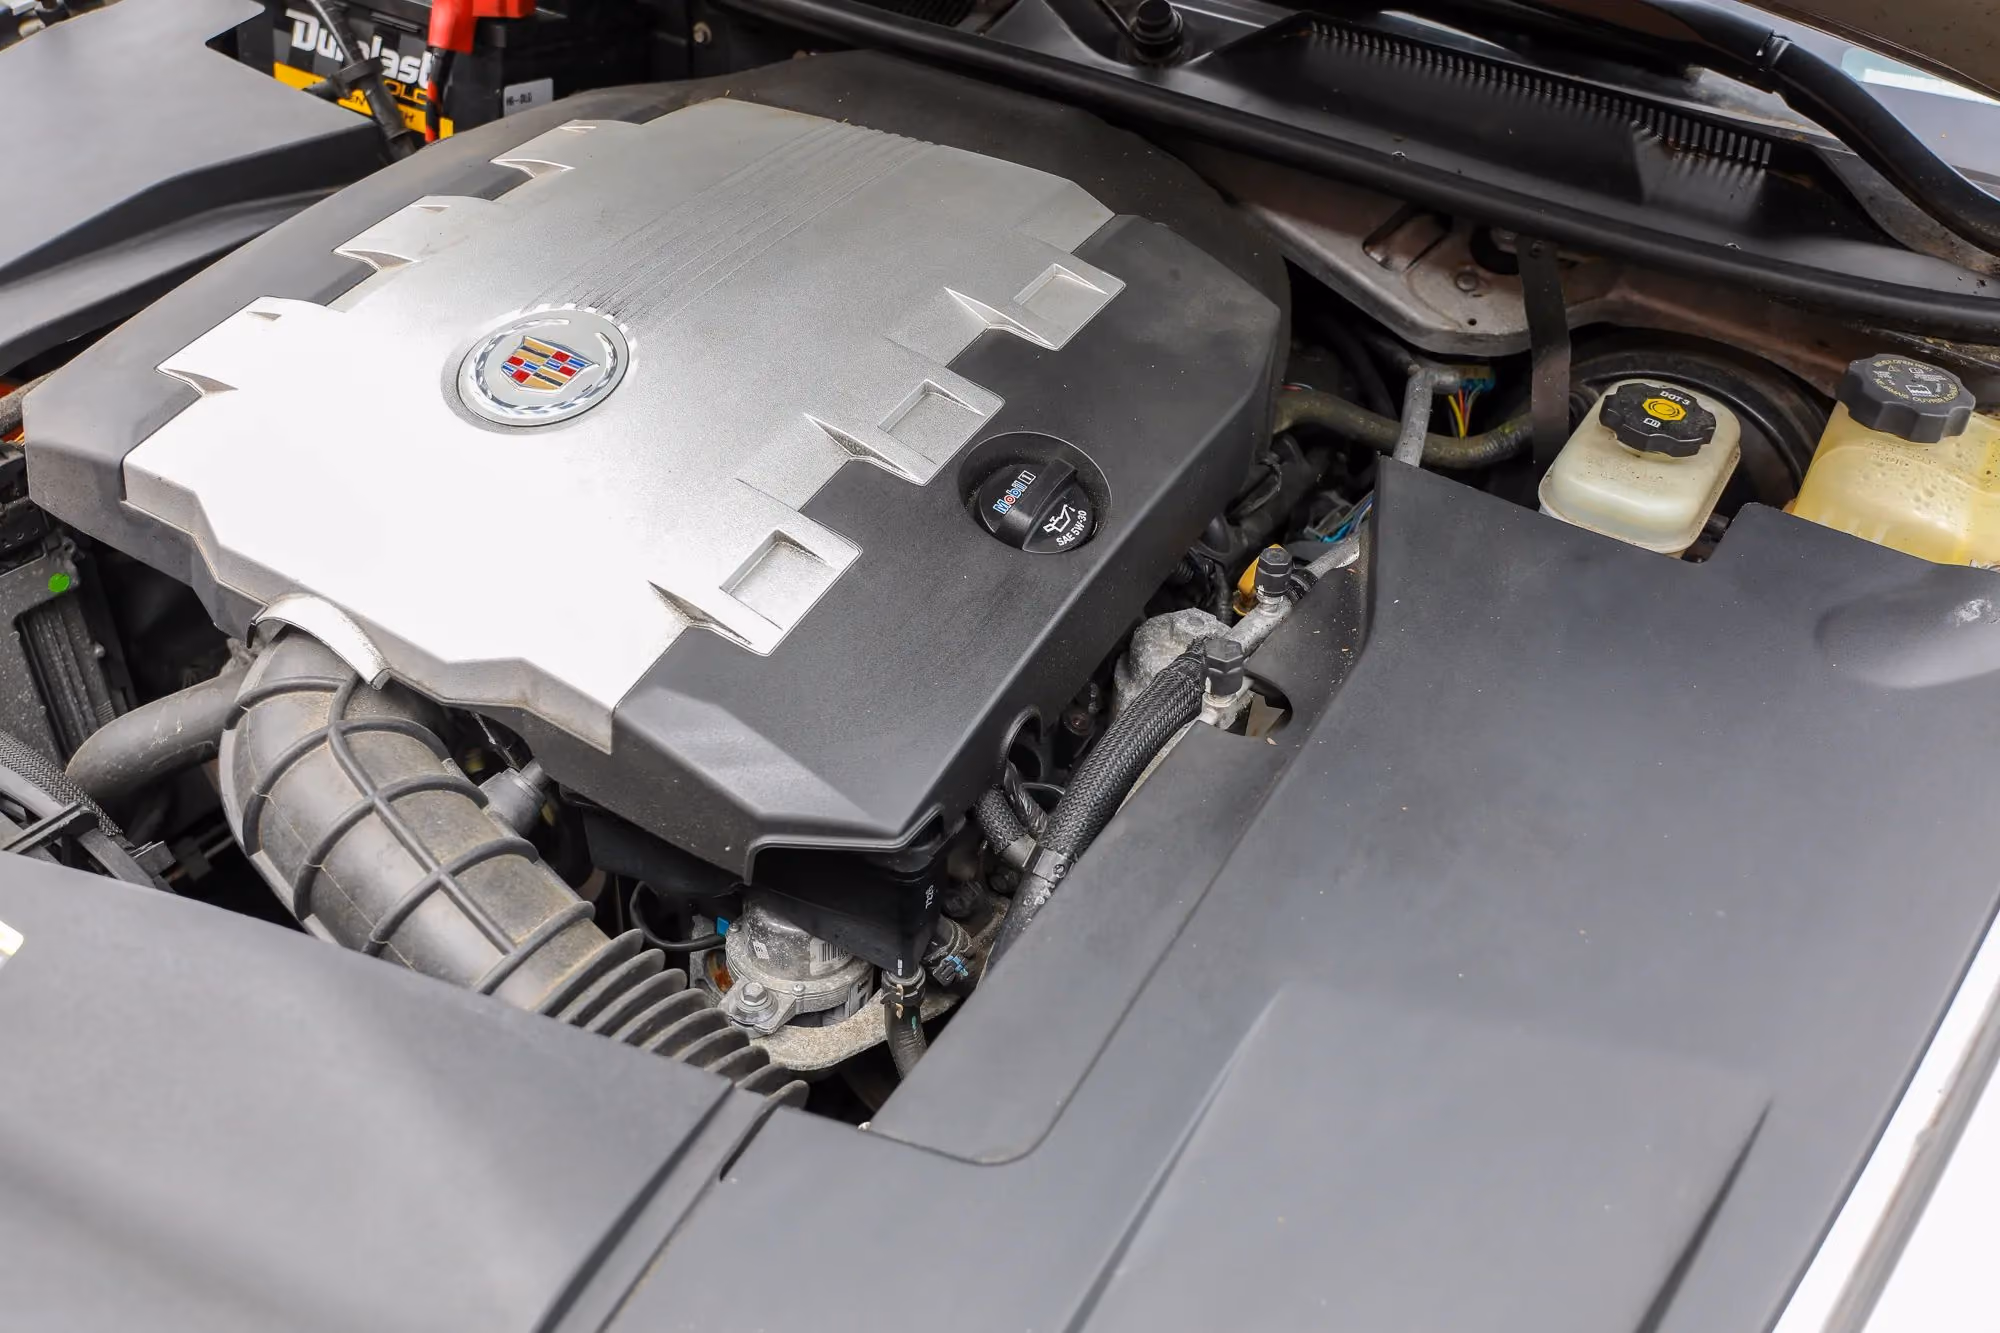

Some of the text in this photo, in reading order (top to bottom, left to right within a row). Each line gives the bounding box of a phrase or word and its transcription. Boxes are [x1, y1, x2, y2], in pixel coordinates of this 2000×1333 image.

[992, 479, 1028, 515] Mobil
[1056, 510, 1087, 546] SAE 5W-30
